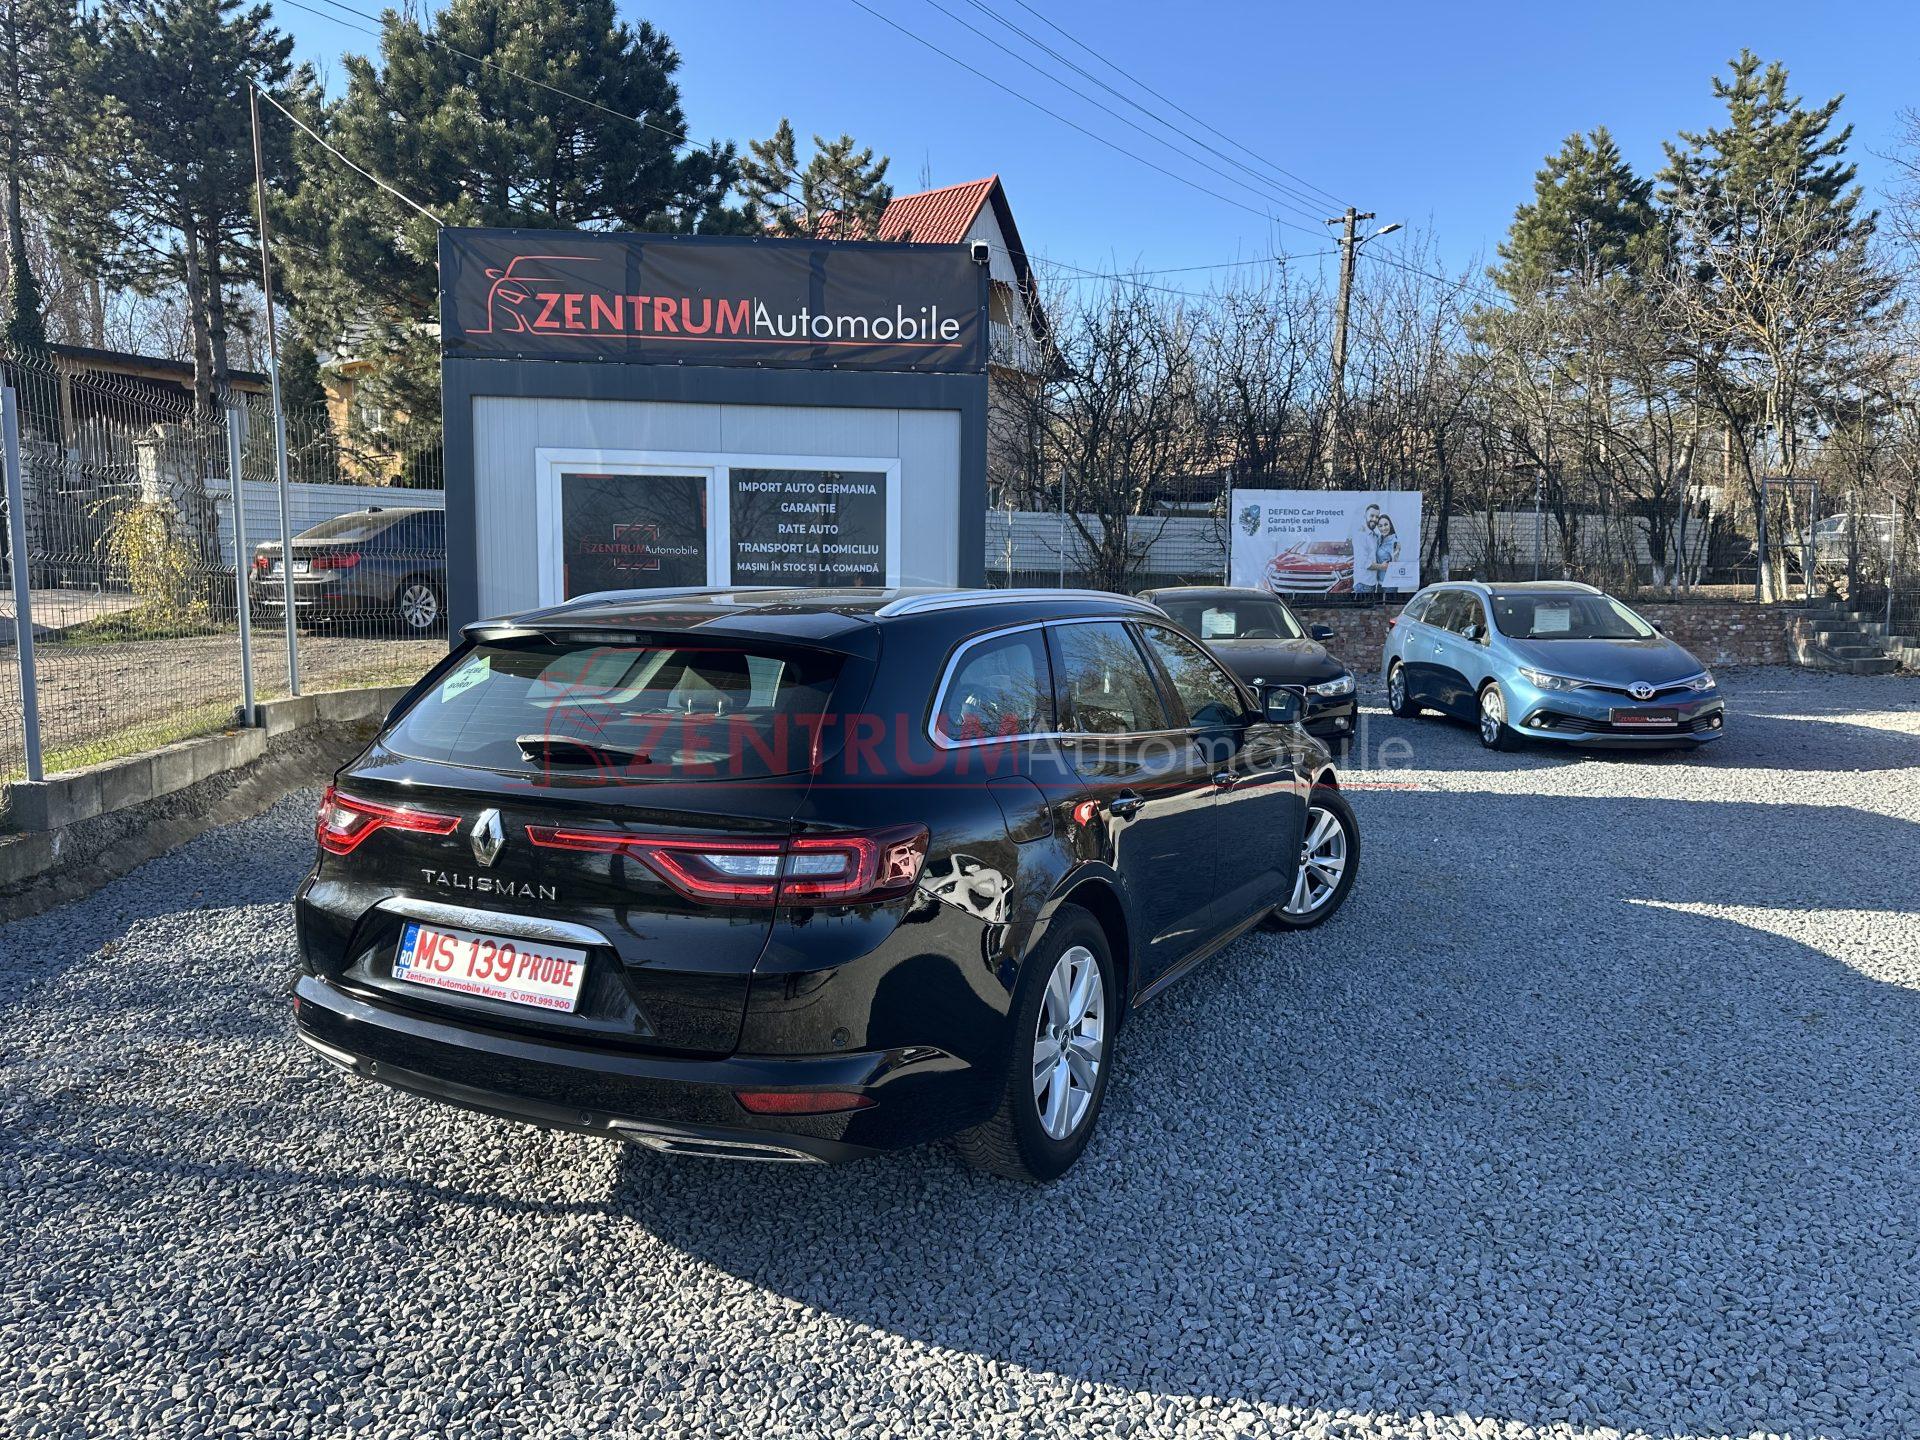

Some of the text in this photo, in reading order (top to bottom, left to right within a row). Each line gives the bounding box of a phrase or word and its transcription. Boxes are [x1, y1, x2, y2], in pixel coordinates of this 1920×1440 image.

[533, 293, 960, 341] ZENTRUM Automobile
[739, 482, 876, 494] IMPORT AUTO GERMANIA
[781, 503, 836, 516] GARANȚIE
[778, 524, 838, 534] RATE AUTO
[591, 544, 698, 555] ZENTRUM Automobile
[738, 543, 878, 554] TRANSPORT LA DOMICILIU
[737, 563, 769, 573] MAȘINI
[771, 562, 780, 571] ÎN
[809, 564, 816, 574] ȘI
[833, 563, 879, 572] COMANDĂ
[421, 869, 556, 900] TALISMAN
[400, 951, 412, 966] RO
[414, 931, 577, 987] MS 139 PROBE
[406, 971, 436, 984] Zentrum
[437, 978, 481, 994] Automobile
[520, 994, 570, 1009] 0751.999.900
